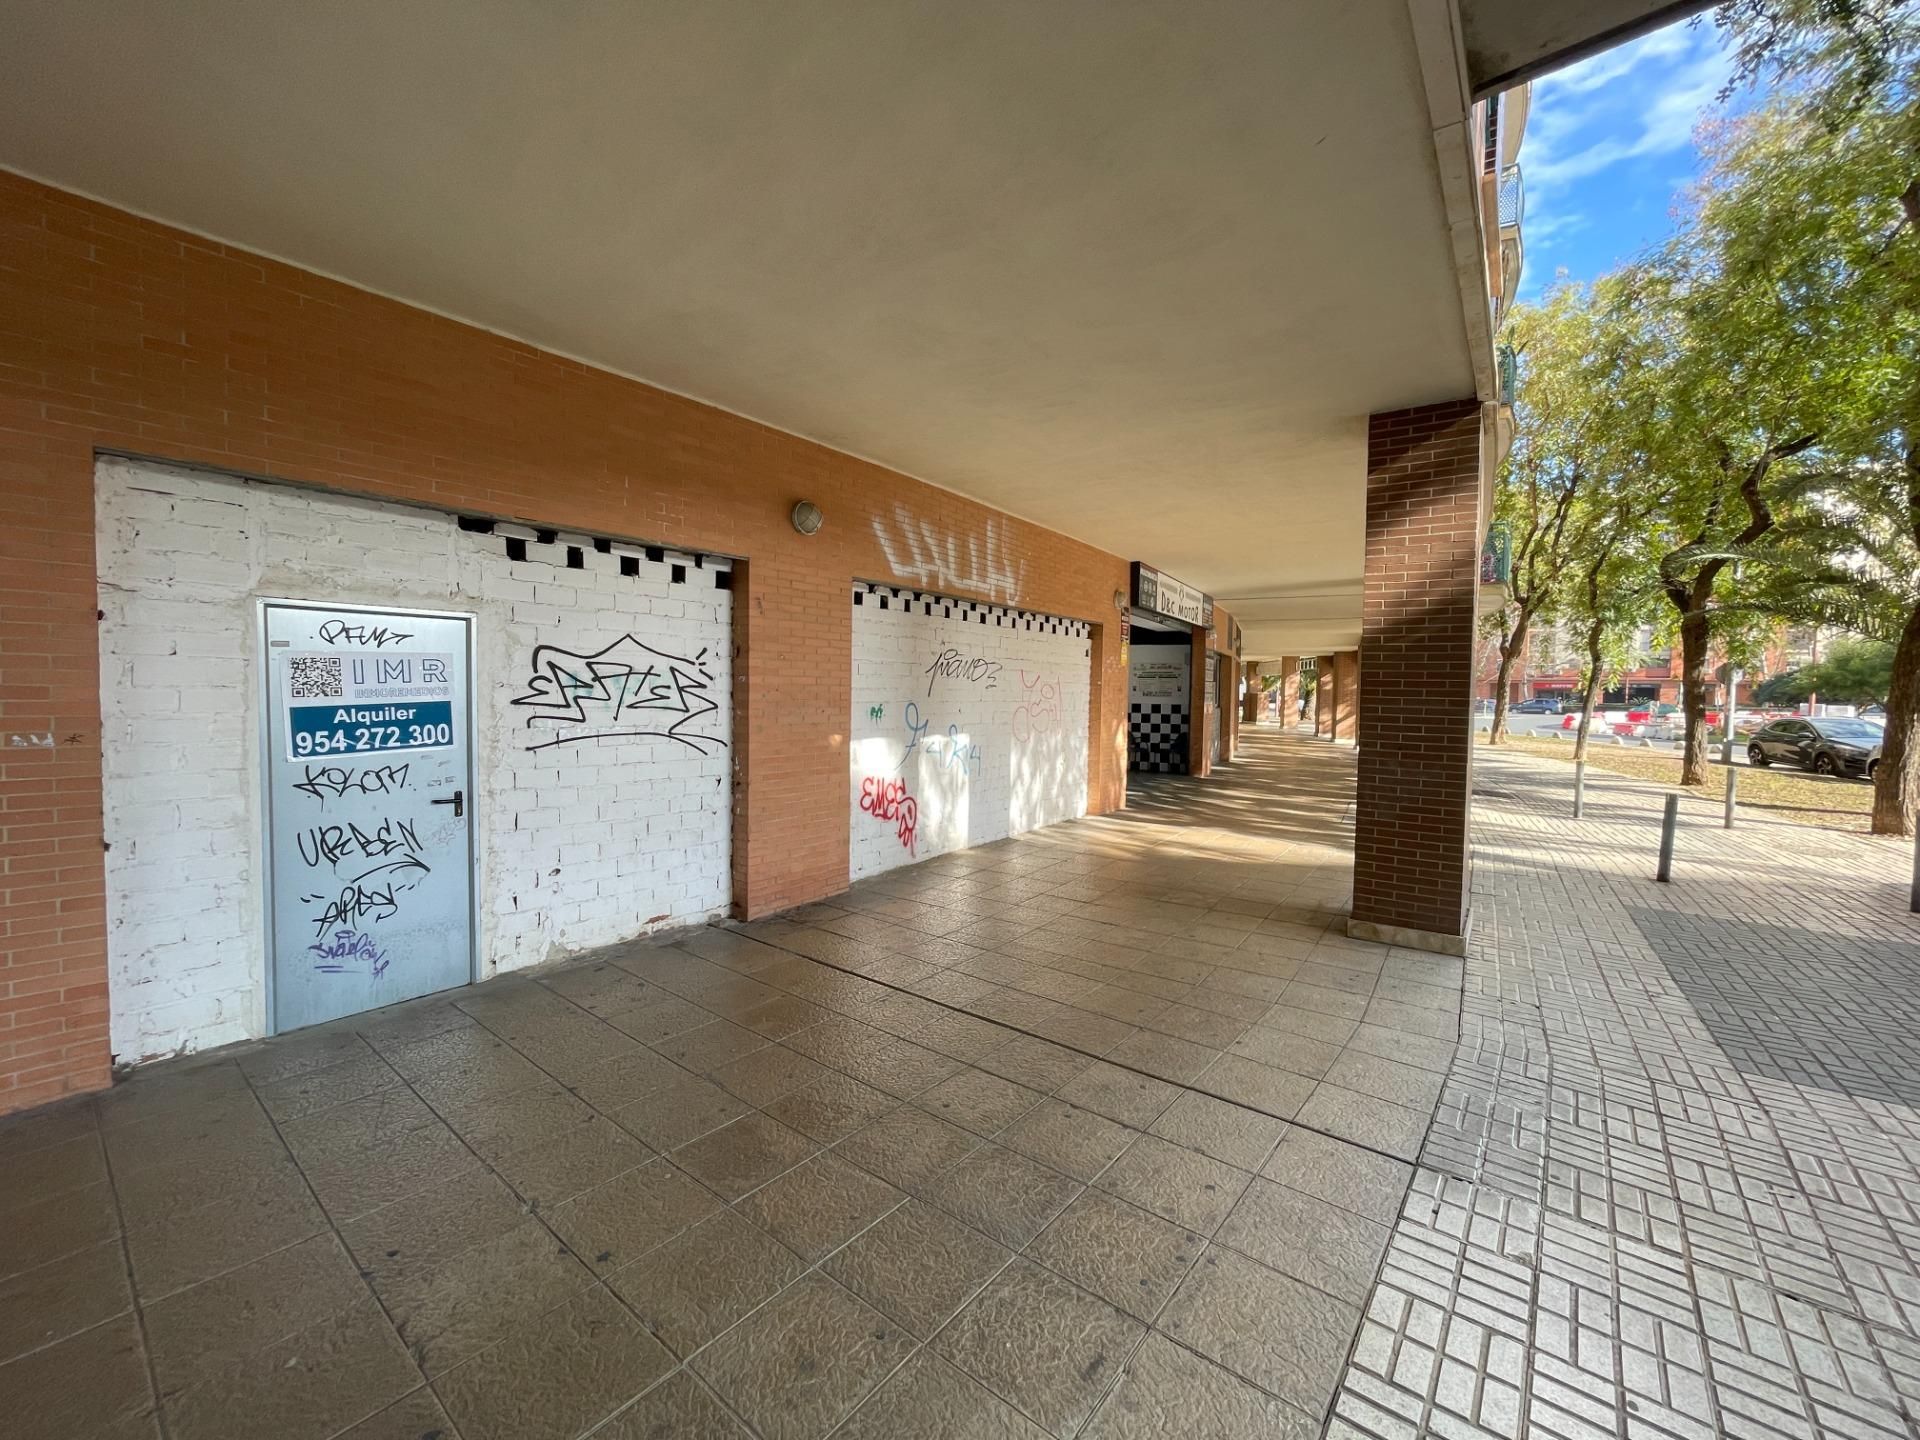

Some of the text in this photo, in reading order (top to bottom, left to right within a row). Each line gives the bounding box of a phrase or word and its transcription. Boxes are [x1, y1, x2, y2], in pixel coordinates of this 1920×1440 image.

[1161, 590, 1175, 614] D&C
[1178, 604, 1199, 624] MOTOR
[333, 706, 416, 725] Alquiler
[296, 723, 450, 754] 954 272 300
